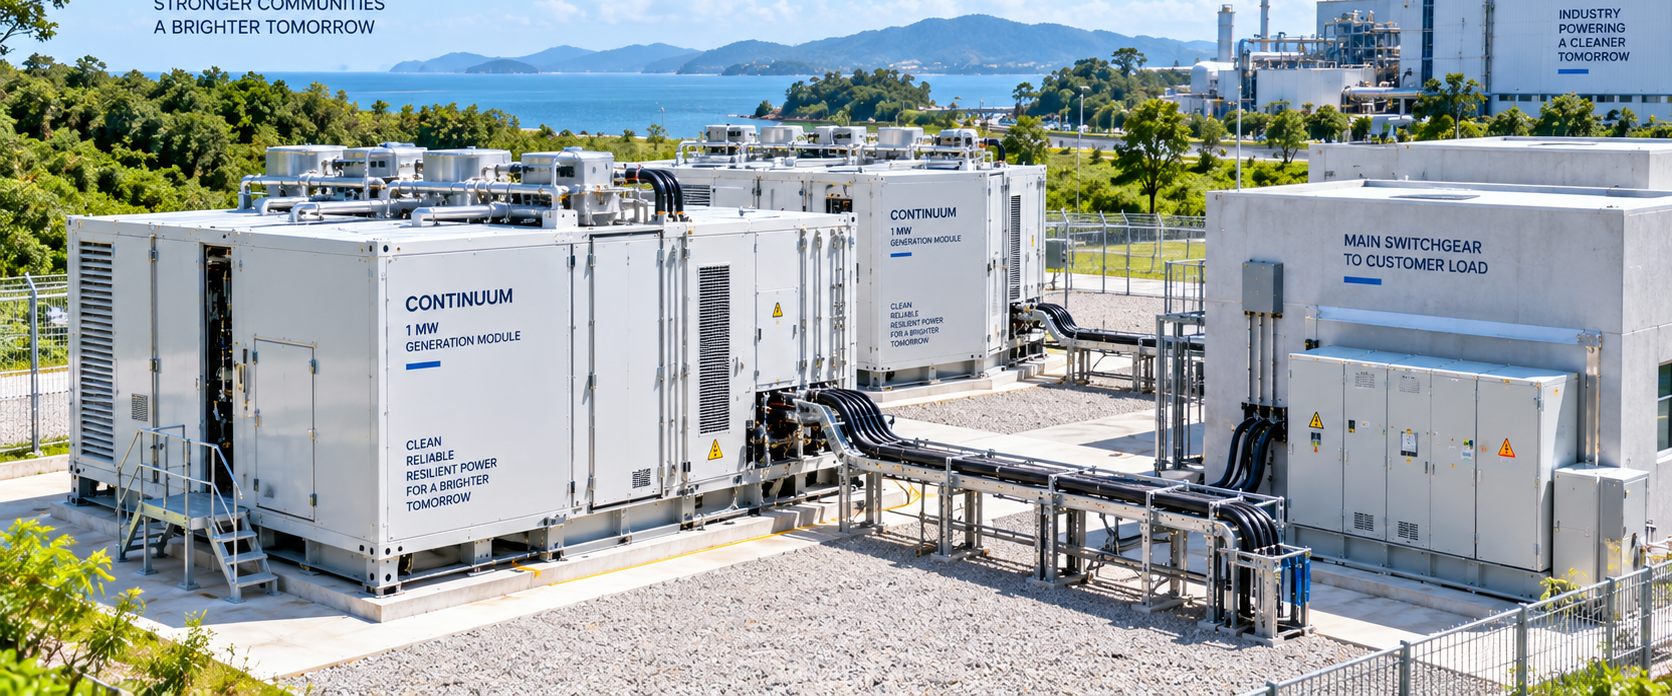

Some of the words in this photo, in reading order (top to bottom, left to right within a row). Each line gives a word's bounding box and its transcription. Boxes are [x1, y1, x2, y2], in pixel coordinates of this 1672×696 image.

[1560, 8, 1620, 20] INDUSTRY
[1559, 23, 1625, 34] POWERING
[1559, 38, 1567, 48] A
[1570, 37, 1626, 48] CLEANER
[1558, 51, 1630, 62] TOMORROW
[890, 207, 957, 221] CONTINUUM
[891, 227, 894, 236] 1
[896, 227, 912, 235] MW
[890, 236, 932, 246] GENERATION
[934, 234, 961, 244] MODULE
[1345, 234, 1381, 248] MAIN
[1385, 236, 1482, 254] SWITCHGEAR
[1344, 253, 1362, 266] TO
[1366, 255, 1445, 271] CUSTOMER
[1449, 260, 1488, 274] LOAD
[405, 288, 513, 312] CONTINUUM
[890, 302, 912, 310] CLEAN
[922, 317, 944, 325] POWER
[406, 324, 410, 337] 1
[415, 322, 438, 335] MW
[406, 336, 474, 353] GENERATION
[478, 331, 521, 345] MODULE
[406, 436, 441, 451] CLEAN
[406, 450, 454, 466] RELIABLE
[406, 464, 457, 481] RESILIENT
[461, 458, 497, 474] POWER
[406, 484, 428, 497] FOR
[430, 482, 438, 493] A
[440, 474, 490, 492] BRIGHTER
[406, 492, 472, 512] TOMORROW
